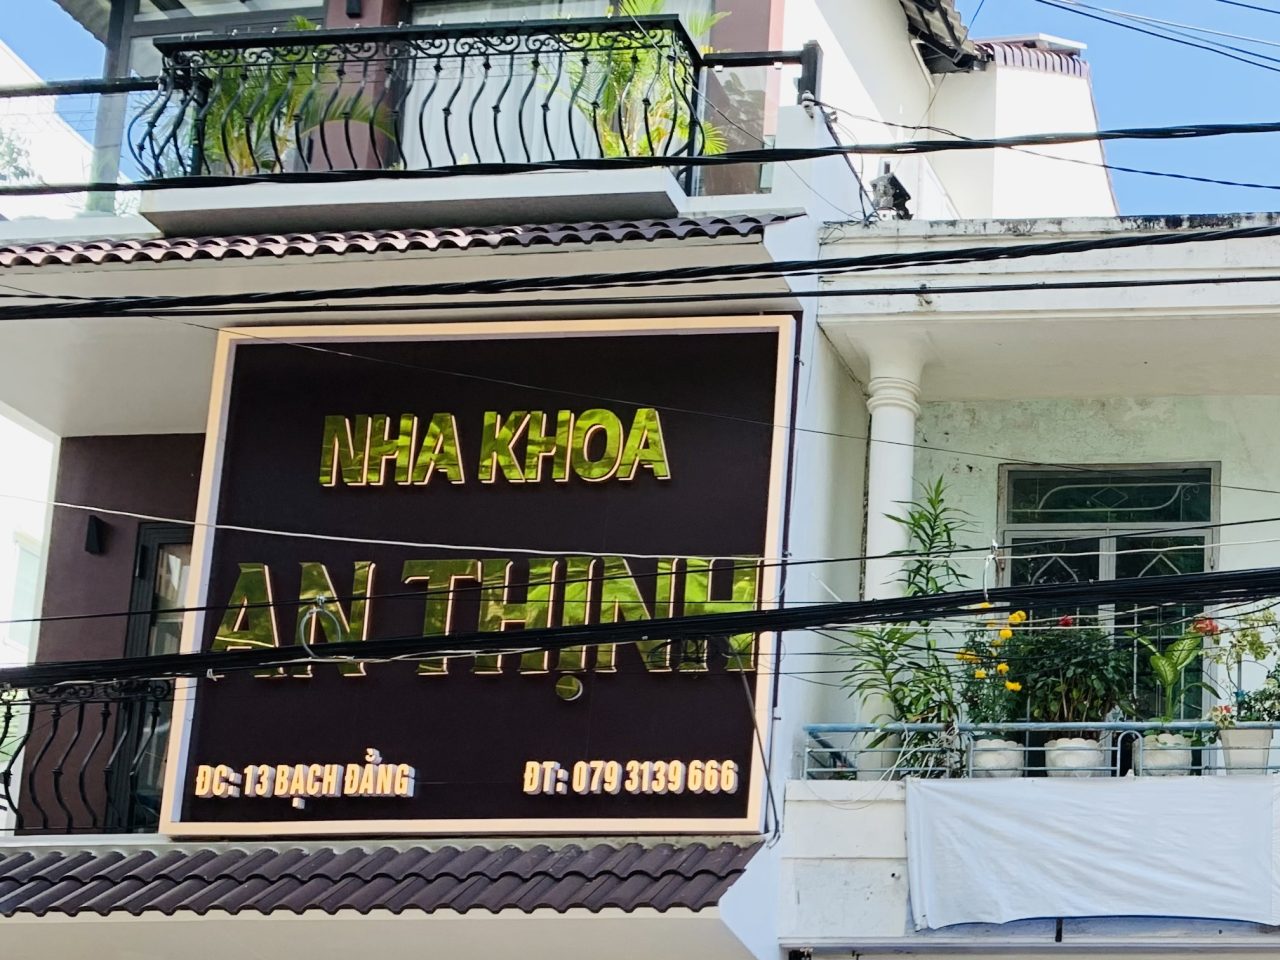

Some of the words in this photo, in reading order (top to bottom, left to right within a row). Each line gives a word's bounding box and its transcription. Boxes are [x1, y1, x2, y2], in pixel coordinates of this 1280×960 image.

[319, 412, 465, 487] NHA
[478, 408, 671, 482] KHOA
[207, 561, 376, 677] AN
[402, 556, 759, 701] THỊNH
[195, 764, 242, 798] ĐC:
[244, 764, 275, 798] 13
[274, 763, 344, 809] BẠCH
[523, 761, 568, 795] ĐT:
[572, 760, 622, 795] 079
[624, 759, 686, 795] 3139
[687, 759, 739, 795] 666
